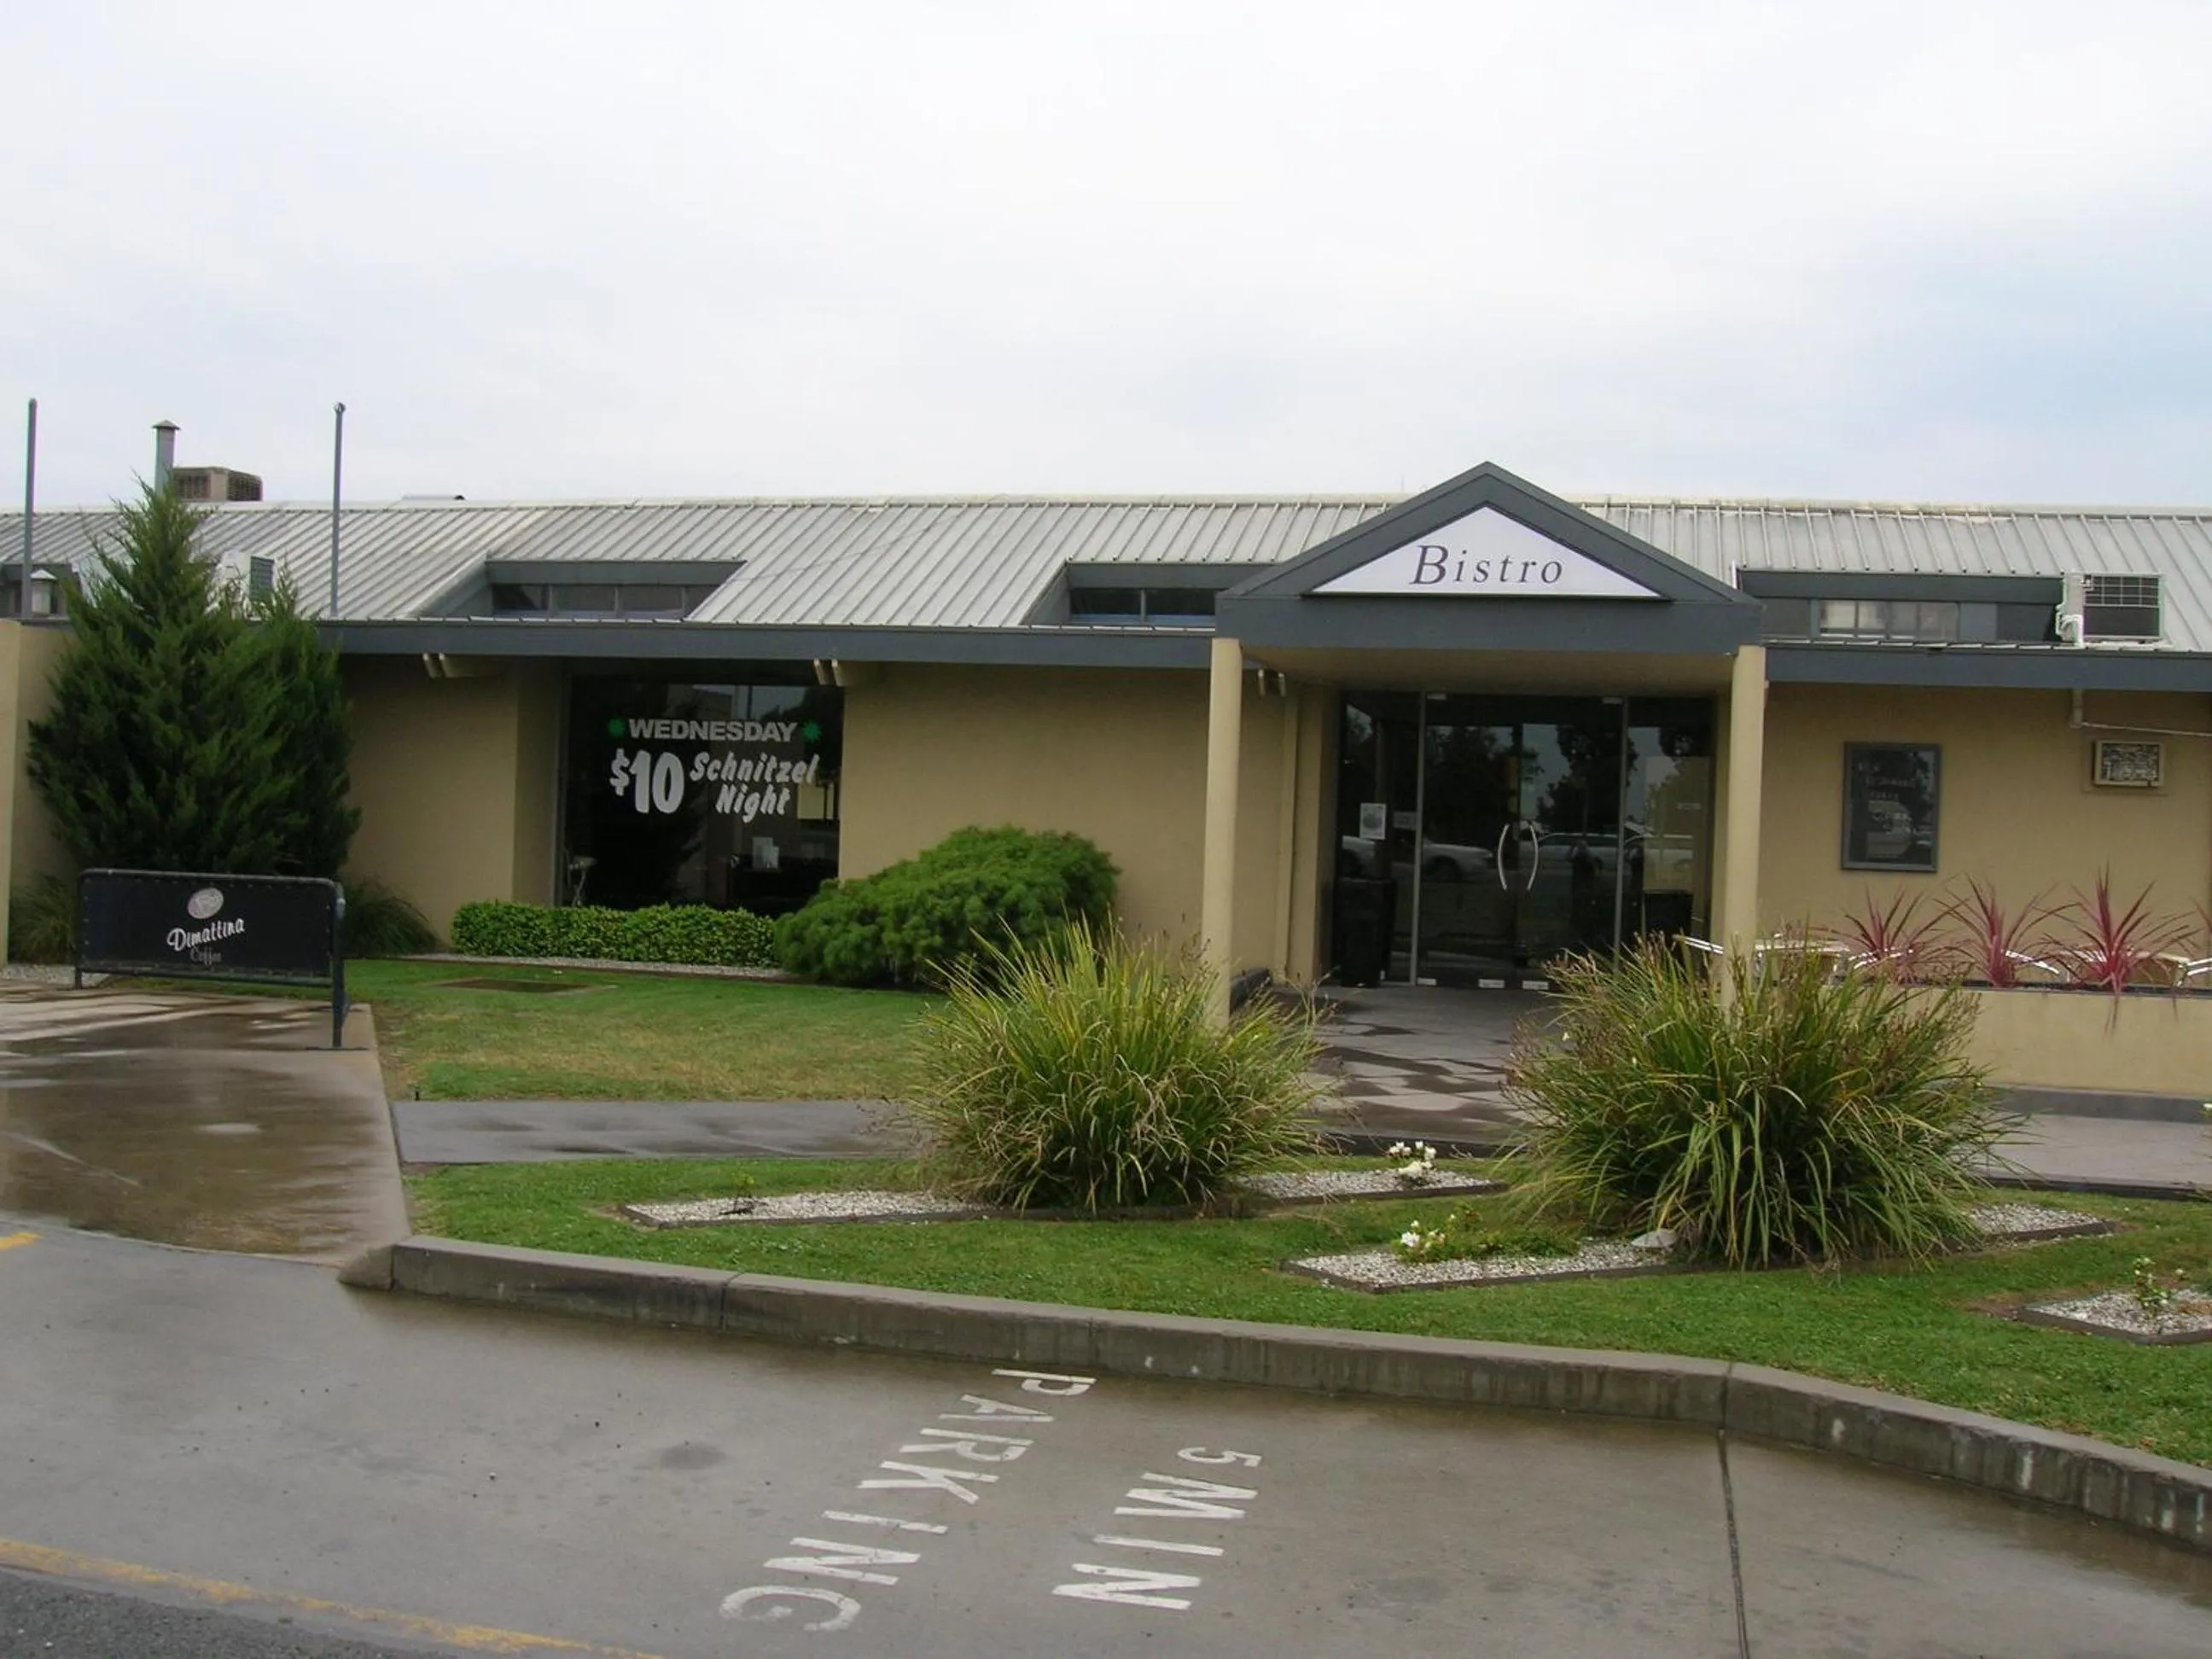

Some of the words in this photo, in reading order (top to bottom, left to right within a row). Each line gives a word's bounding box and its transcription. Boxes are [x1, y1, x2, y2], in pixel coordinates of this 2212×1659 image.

[1409, 544, 1563, 585] Bistro
[628, 719, 798, 742] WEDNESDAY
[609, 748, 684, 813] $10
[690, 751, 819, 783] Schnitzel
[716, 784, 791, 824] Night
[166, 918, 246, 952] Dimattina
[1176, 1446, 1262, 1468] 5
[719, 1367, 1097, 1632] PARKING
[1051, 1471, 1259, 1611] MIN
